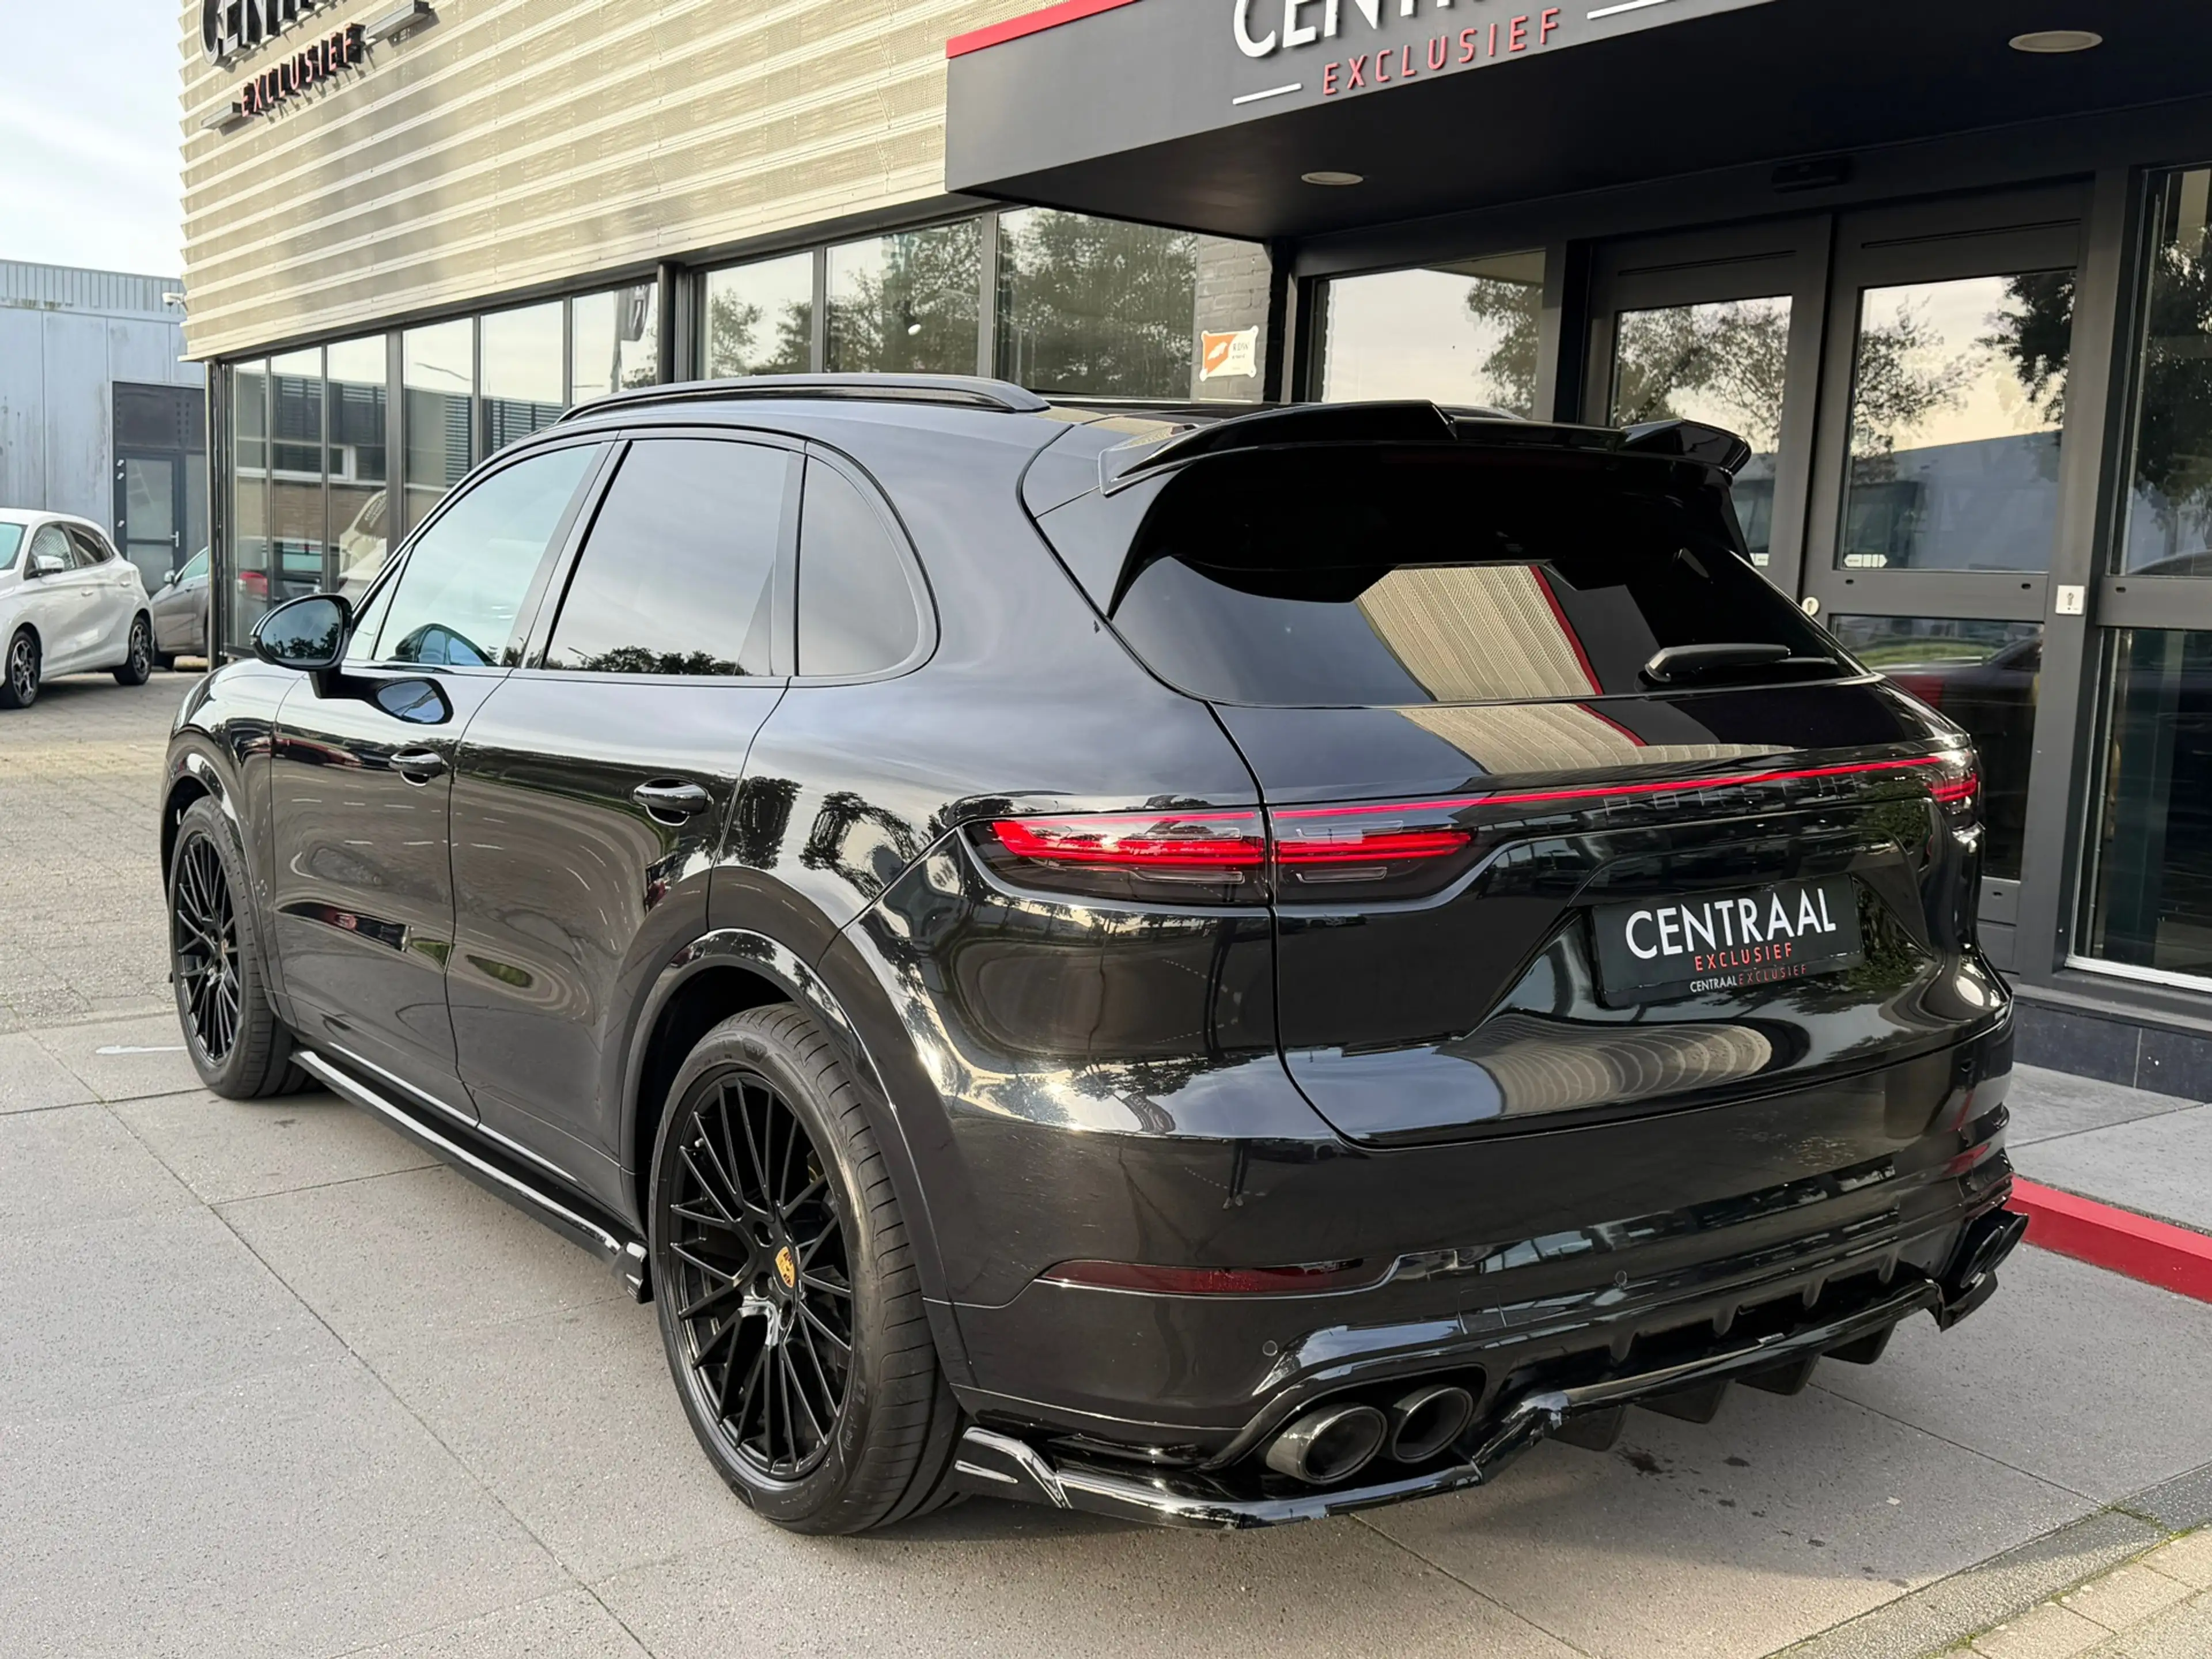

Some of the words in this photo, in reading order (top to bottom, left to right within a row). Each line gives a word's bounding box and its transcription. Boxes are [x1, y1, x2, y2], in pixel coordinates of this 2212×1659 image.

[240, 22, 353, 117] EXCLUSIEF
[1322, 7, 1560, 96] EXCLUSIEF
[1625, 888, 1836, 959] CENTRAAL
[1694, 942, 1793, 972] EXCLUSIEF
